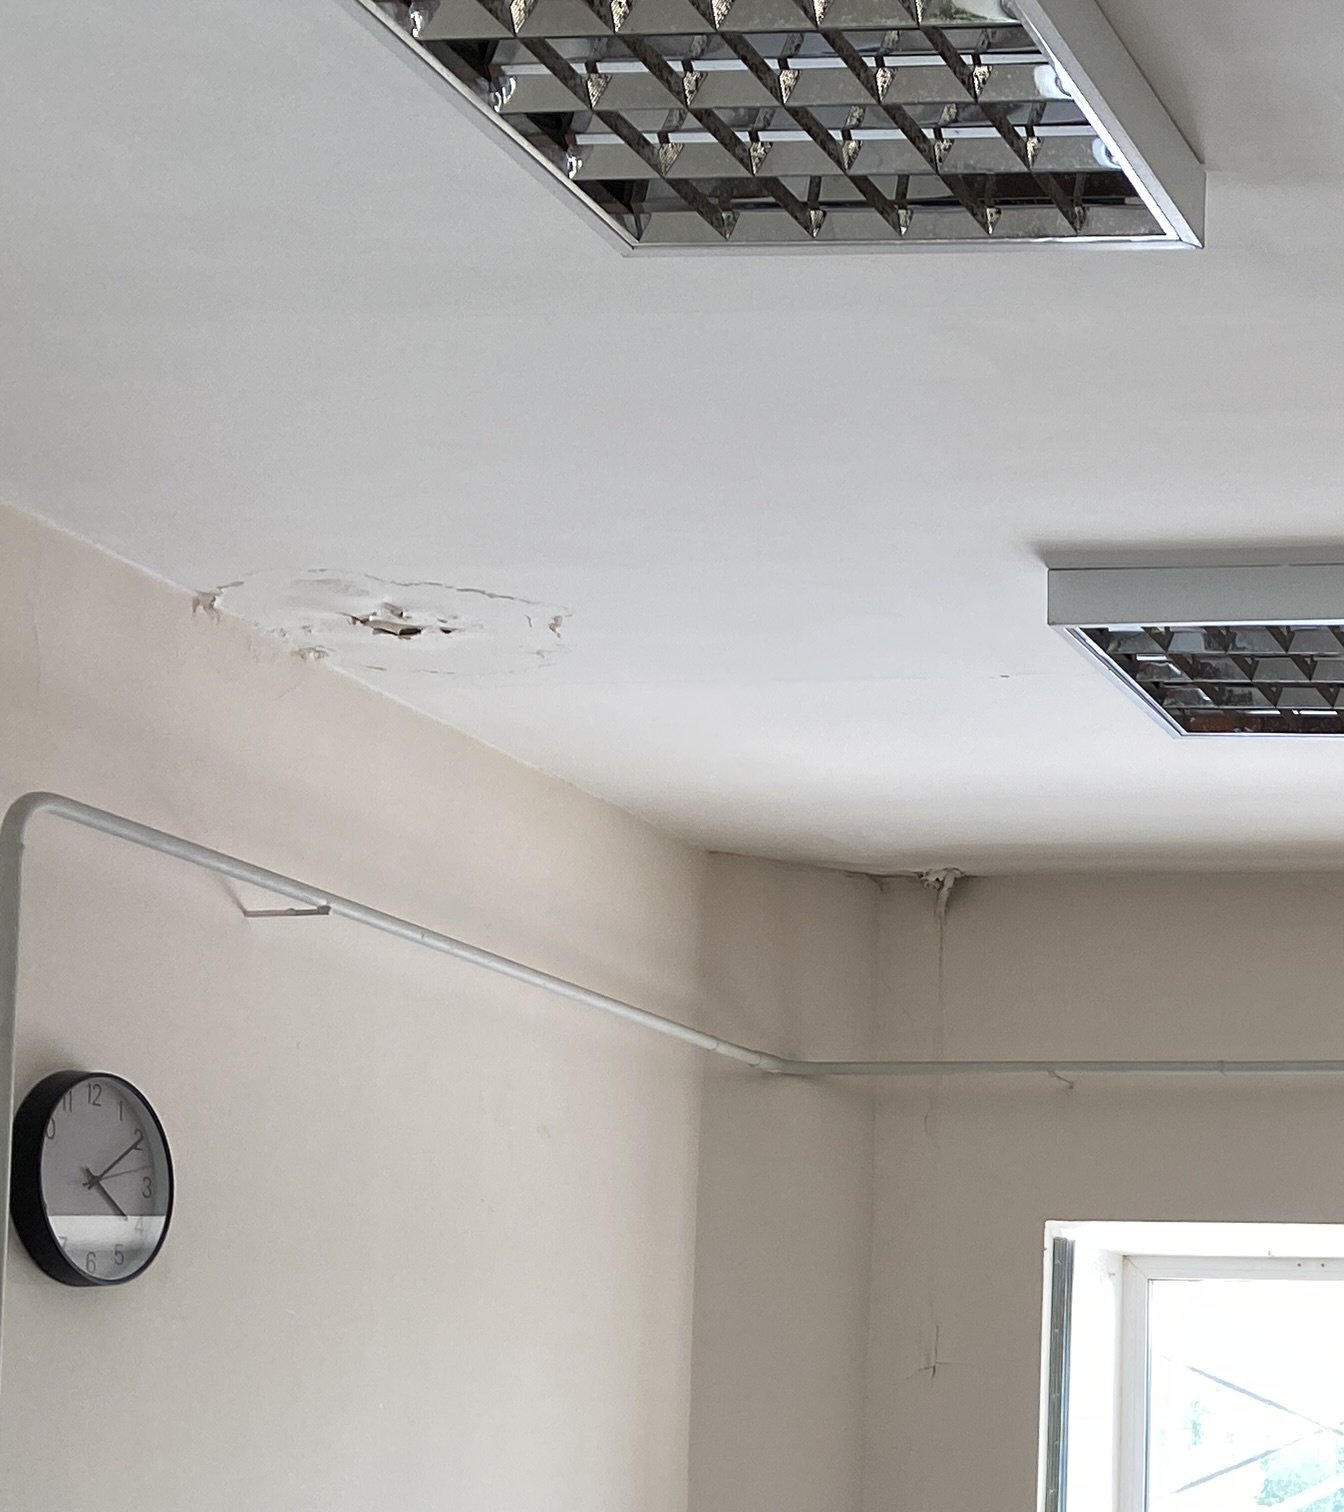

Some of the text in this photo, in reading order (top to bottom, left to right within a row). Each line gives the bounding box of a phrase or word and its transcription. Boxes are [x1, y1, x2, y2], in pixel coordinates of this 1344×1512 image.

[87, 1083, 103, 1108] 12
[118, 1100, 124, 1122] 1
[45, 1116, 57, 1140] 0
[133, 1128, 145, 1152] 2
[141, 1176, 153, 1199] 3
[134, 1215, 146, 1233] 4
[85, 1251, 97, 1274] 6
[113, 1243, 125, 1267] 5
